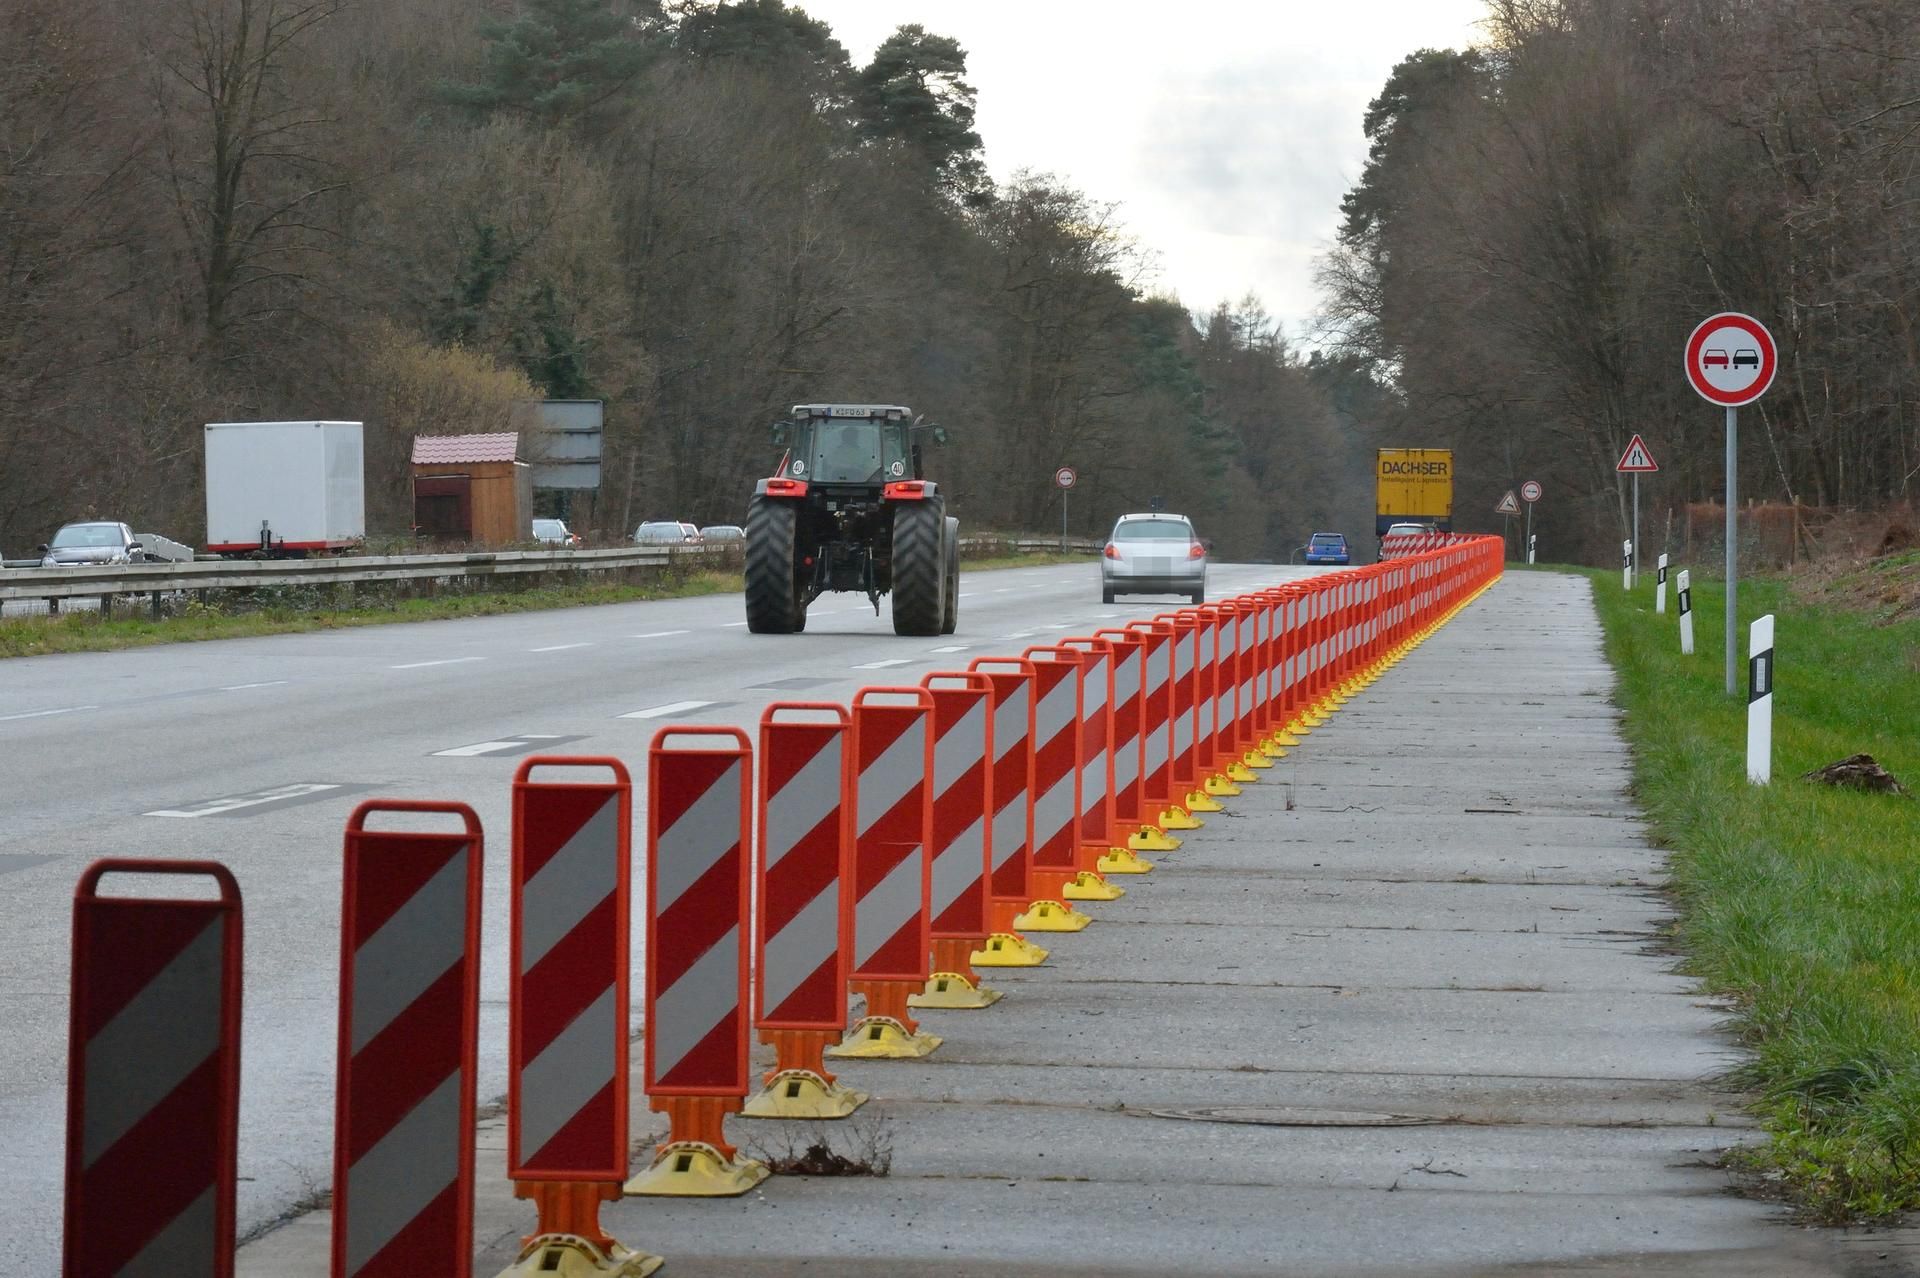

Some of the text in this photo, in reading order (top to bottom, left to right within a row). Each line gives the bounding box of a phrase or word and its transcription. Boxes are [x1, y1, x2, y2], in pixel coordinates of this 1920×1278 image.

[794, 462, 802, 473] 40
[893, 464, 902, 475] 40
[1382, 461, 1447, 475] DACHSER
